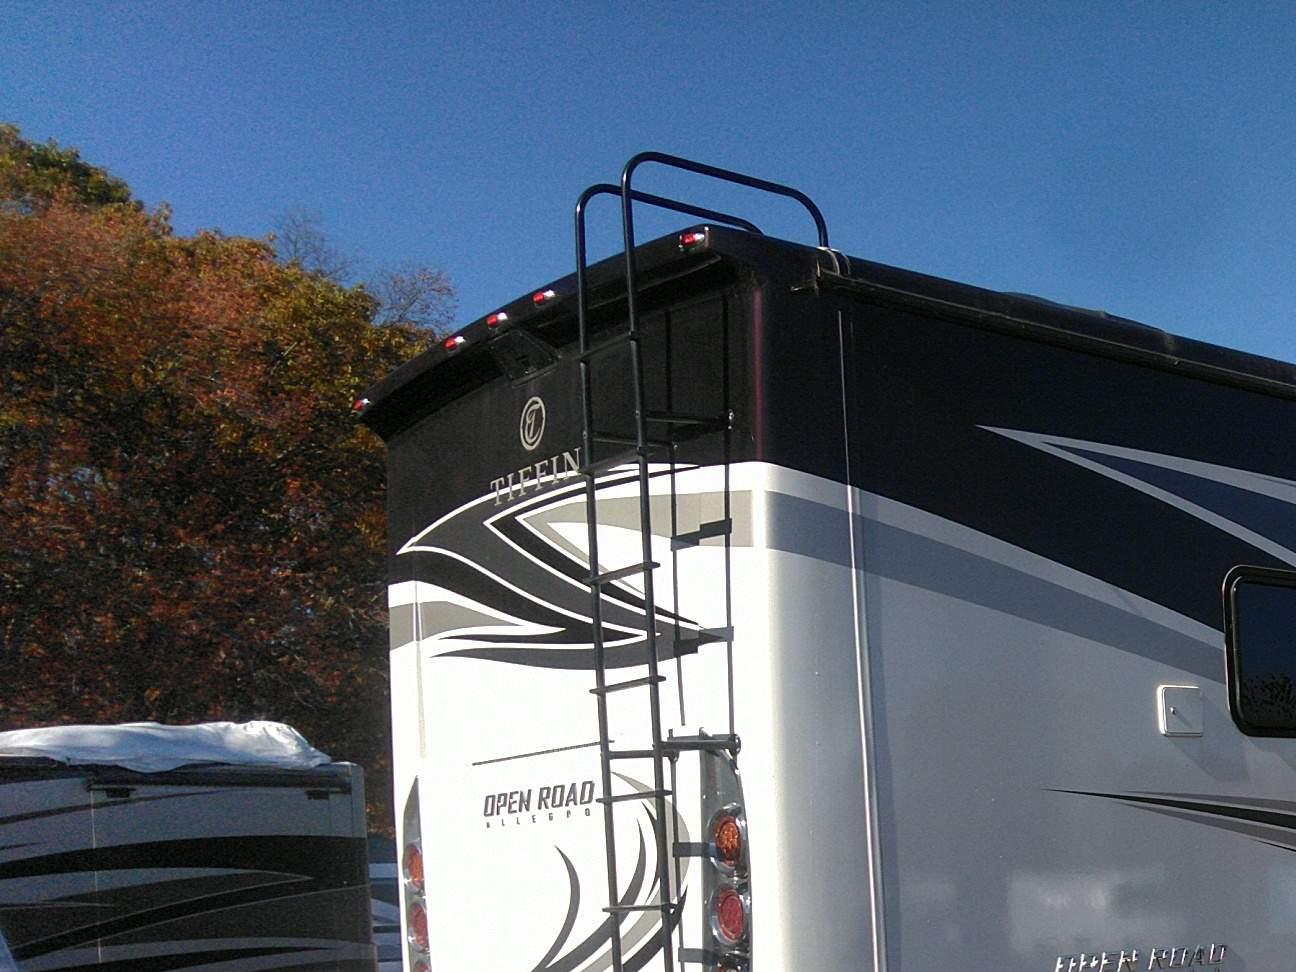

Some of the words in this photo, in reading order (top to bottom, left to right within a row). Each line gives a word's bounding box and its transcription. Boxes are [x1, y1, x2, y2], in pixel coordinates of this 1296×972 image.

[490, 447, 583, 506] TIFFIN
[483, 789, 532, 817] OPEN
[537, 780, 595, 810] ROAD
[486, 807, 591, 828] ALLEGRO
[1148, 943, 1227, 970] ROAD
